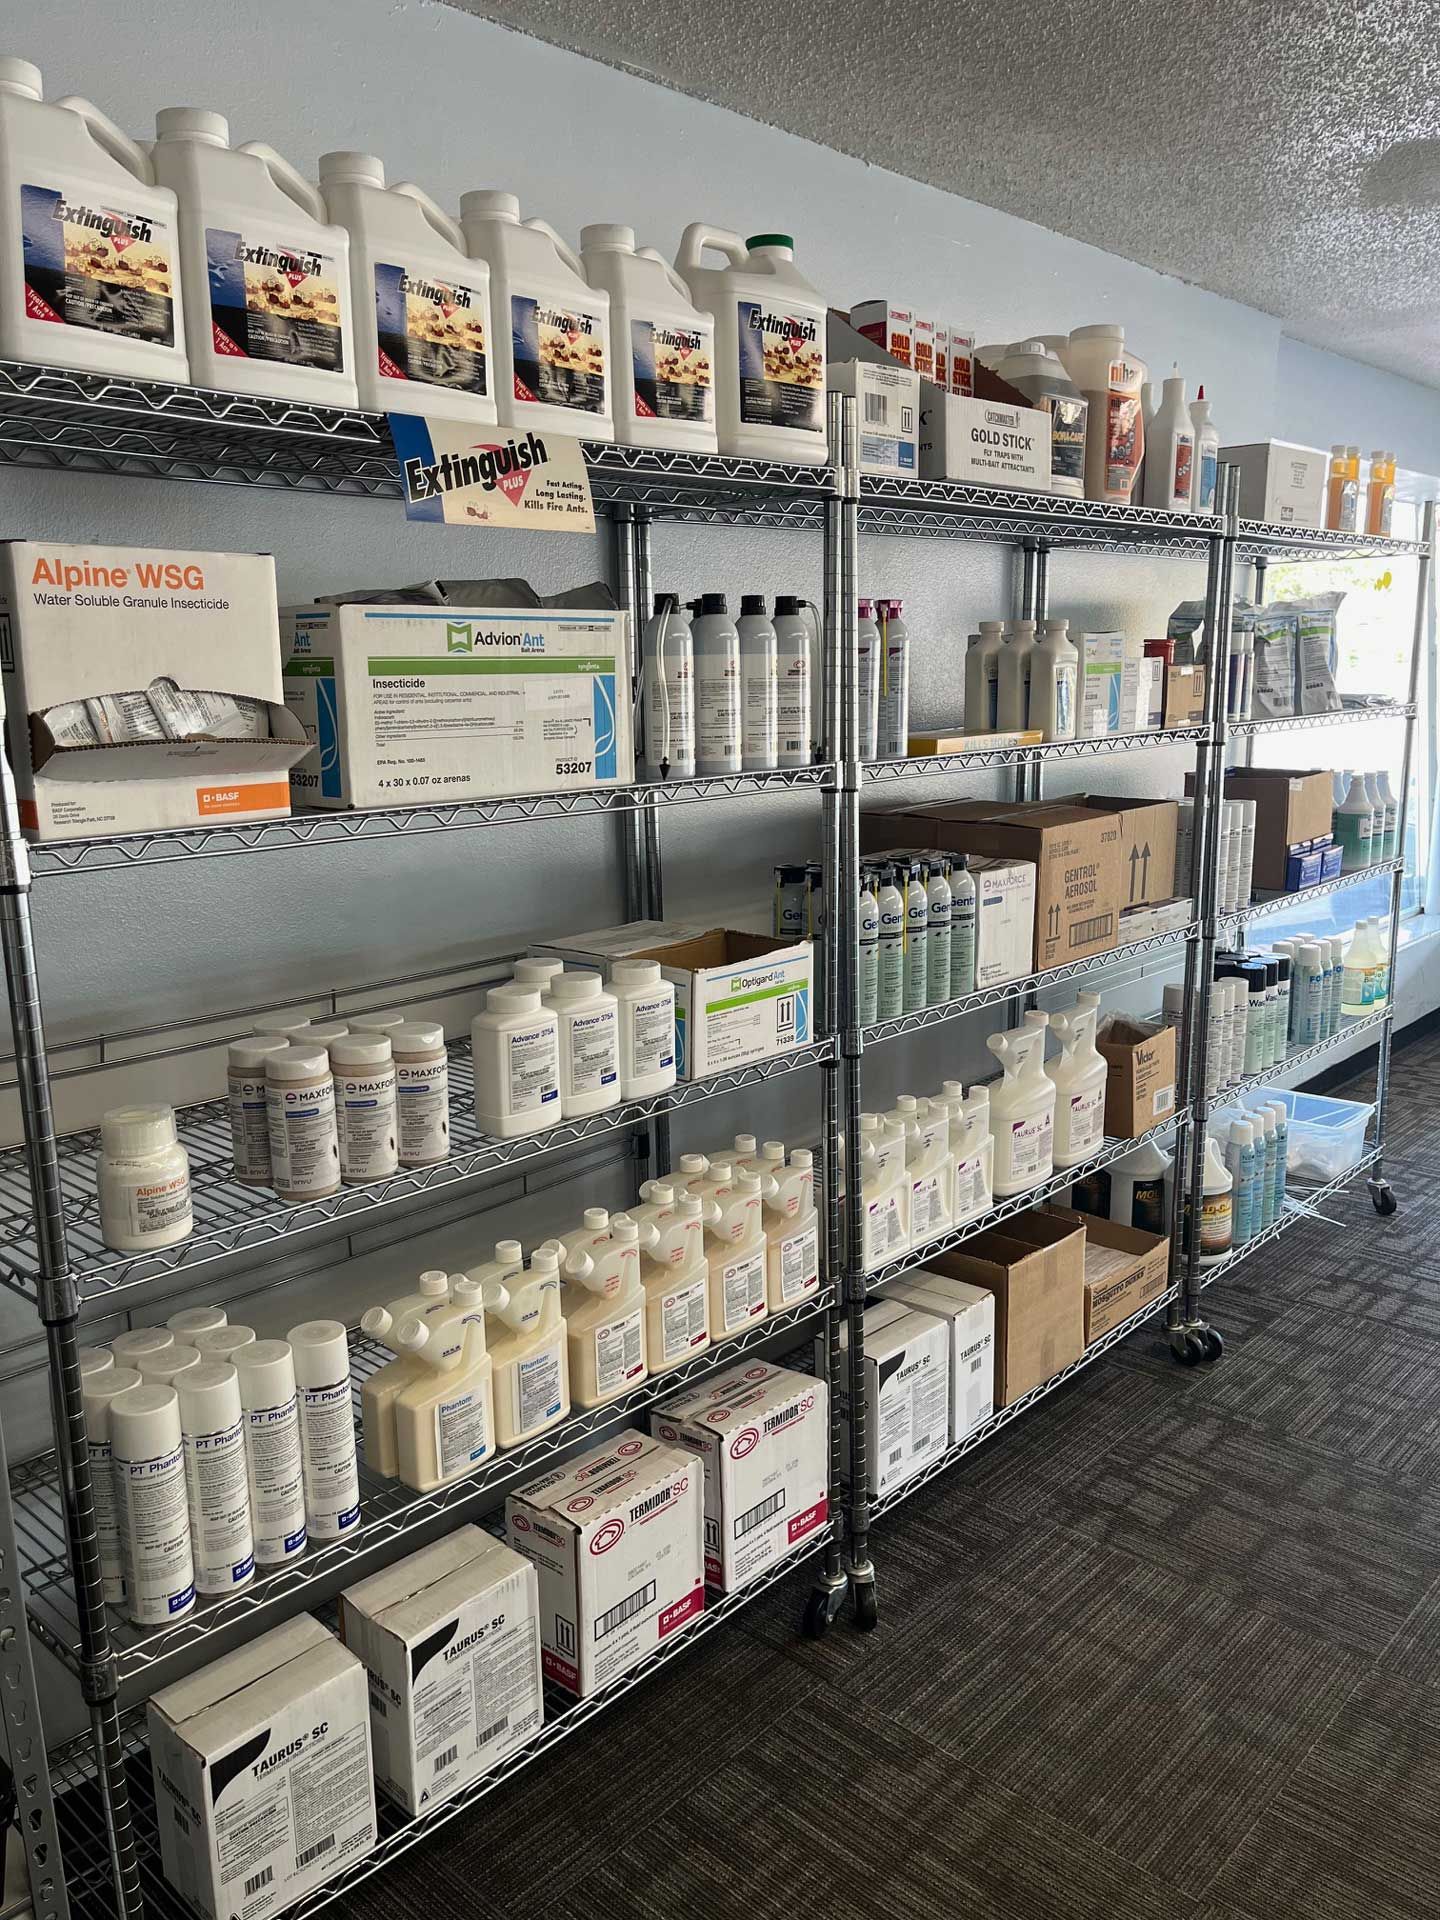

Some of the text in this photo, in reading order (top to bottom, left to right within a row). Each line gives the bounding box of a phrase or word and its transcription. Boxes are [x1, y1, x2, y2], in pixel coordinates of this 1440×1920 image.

[52, 200, 152, 243] Extinguish
[113, 236, 130, 246] PLUS
[233, 240, 322, 277] Extinguish
[288, 273, 302, 281] PLUS
[27, 289, 45, 309] Treats
[398, 273, 471, 308] Extinguish
[32, 305, 45, 319] Acre
[531, 306, 592, 335] Extinguish
[749, 309, 816, 342] Extinguish
[215, 327, 230, 346] Treats
[649, 327, 701, 351] Extinguish
[891, 332, 910, 351] GOLD
[220, 342, 231, 353] Acre
[916, 341, 933, 361] GOLD
[914, 357, 935, 376] STICK
[953, 355, 971, 373] GOLD
[952, 370, 972, 388] STICK
[971, 427, 1033, 451] GOLD STICK
[983, 448, 1024, 462] FLY TRAPS WITH
[405, 432, 548, 502] Extinguish
[971, 457, 1035, 473] MULTI-BAIT ATTRACTANTS
[503, 475, 524, 492] PLUS
[546, 479, 585, 491] Fast Acting.
[535, 489, 586, 502] Long Lasting.
[524, 499, 589, 514] Kills Fire Ants.
[32, 557, 205, 592] Alpine WSG
[33, 593, 230, 610] Water Soluble Granule Insecticide
[294, 632, 311, 648] Ant
[474, 631, 545, 648] Advion Ant
[372, 678, 426, 689] Insecticide
[555, 761, 592, 775] 53207
[290, 773, 319, 788] 53207
[378, 779, 384, 788] 4
[386, 780, 391, 788] x
[393, 778, 404, 787] 30
[412, 776, 430, 786] 0.07
[431, 777, 442, 785] oz
[443, 773, 471, 784] arenas
[215, 791, 240, 803] BASF
[992, 874, 1027, 889] MAXFORCE
[1064, 864, 1097, 883] GENTROL
[1064, 879, 1098, 899] AEROSOL
[741, 970, 785, 989] Optigard Ant
[635, 1002, 660, 1014] Advance
[573, 1016, 600, 1028] Advance
[511, 1032, 540, 1045] Advance
[1014, 1128, 1036, 1138] TAURUS
[135, 1186, 167, 1198] Alpine
[983, 1333, 992, 1345] SC
[521, 1354, 550, 1372] Phantom
[922, 1354, 931, 1365] SC
[304, 1393, 319, 1403] PT
[441, 1394, 474, 1414] Phantom
[250, 1414, 268, 1424] PT
[763, 1395, 815, 1433] TERMIDOR SC
[195, 1439, 211, 1449] PT
[130, 1465, 145, 1475] PT
[334, 1462, 352, 1474] CAUTION
[280, 1484, 298, 1497] CAUTION
[590, 1474, 624, 1496] TERMIDOR
[628, 1477, 690, 1523] TERMIDOR SC
[227, 1509, 246, 1524] CAUTION
[800, 1510, 817, 1526] BASF
[672, 1599, 692, 1618] BASF
[491, 1614, 506, 1631] SC
[556, 1664, 577, 1681] BASF
[390, 1688, 402, 1705] SC
[311, 1721, 329, 1740] SC
